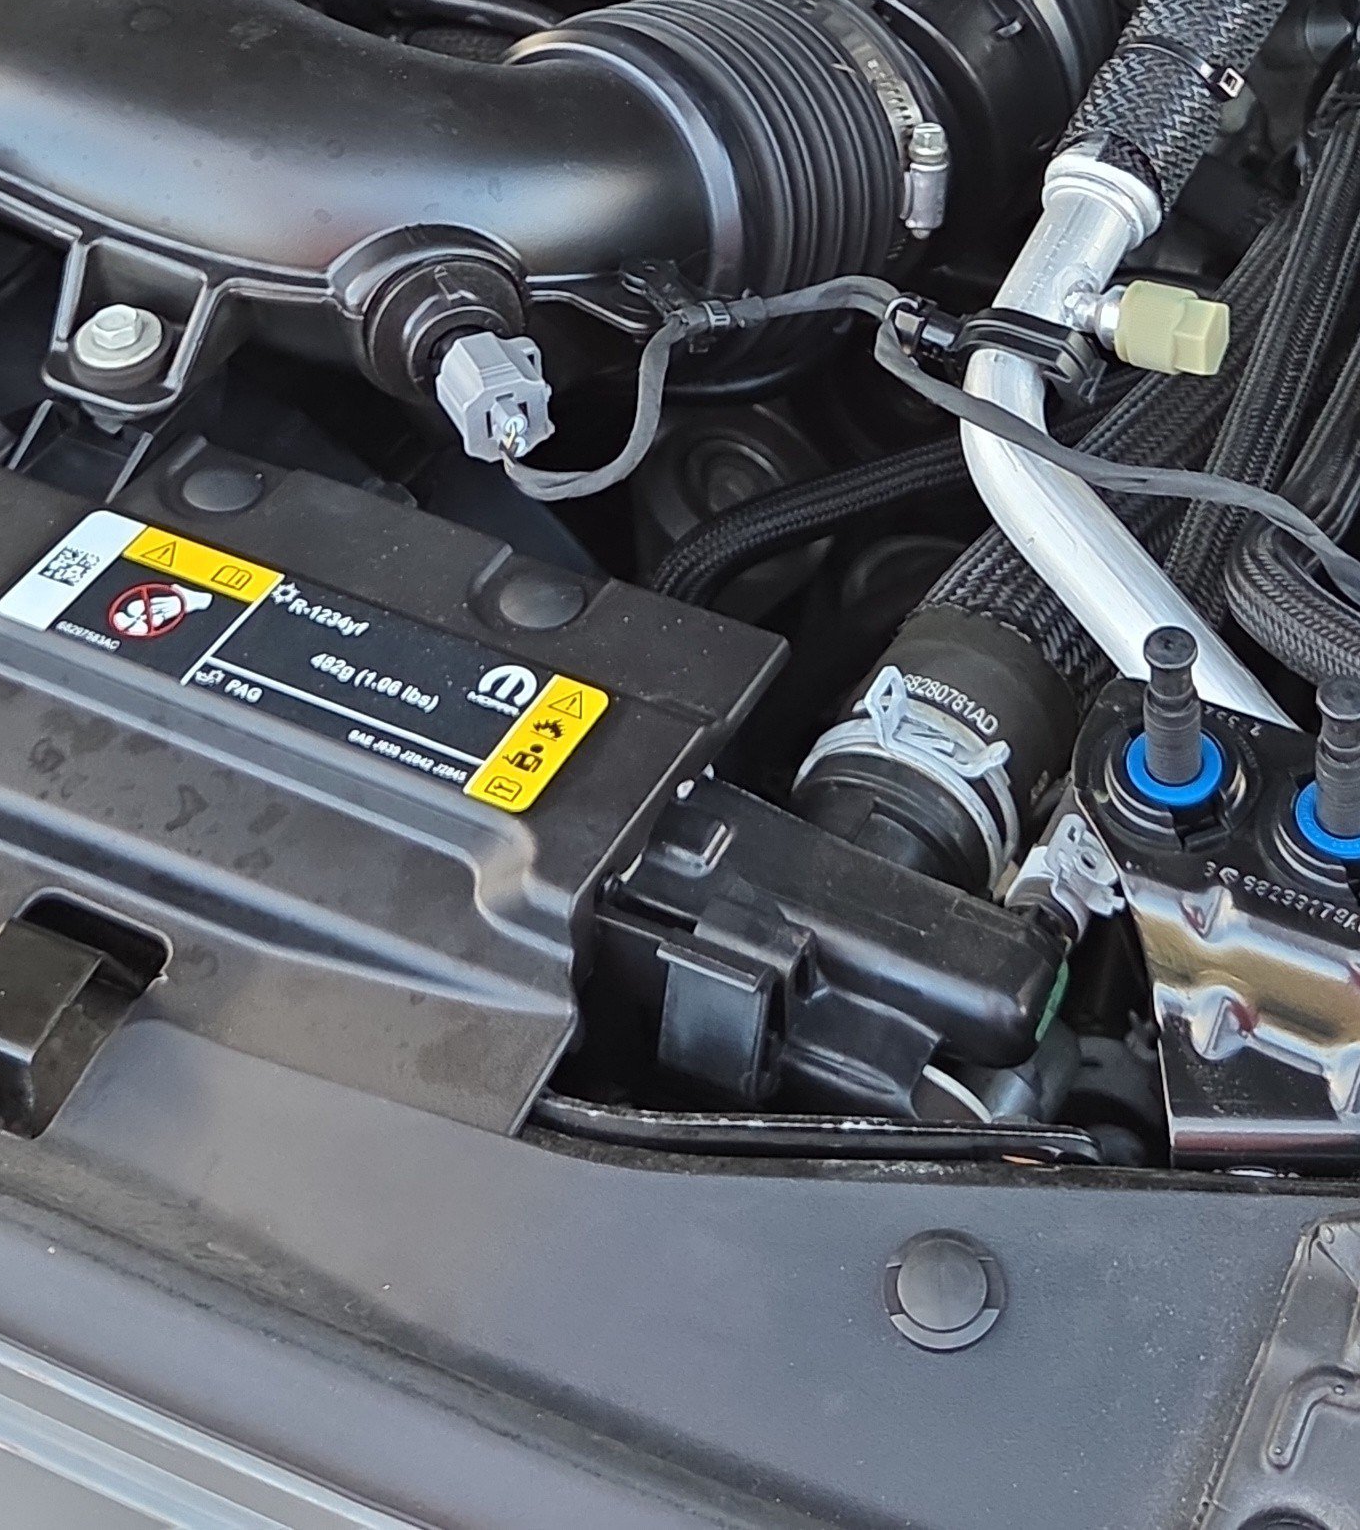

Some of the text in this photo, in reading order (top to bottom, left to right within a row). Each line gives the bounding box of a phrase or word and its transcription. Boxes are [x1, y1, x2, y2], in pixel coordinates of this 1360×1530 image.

[288, 598, 370, 637] R-1234yf
[224, 678, 264, 705] PAG
[400, 680, 440, 713] lbs)
